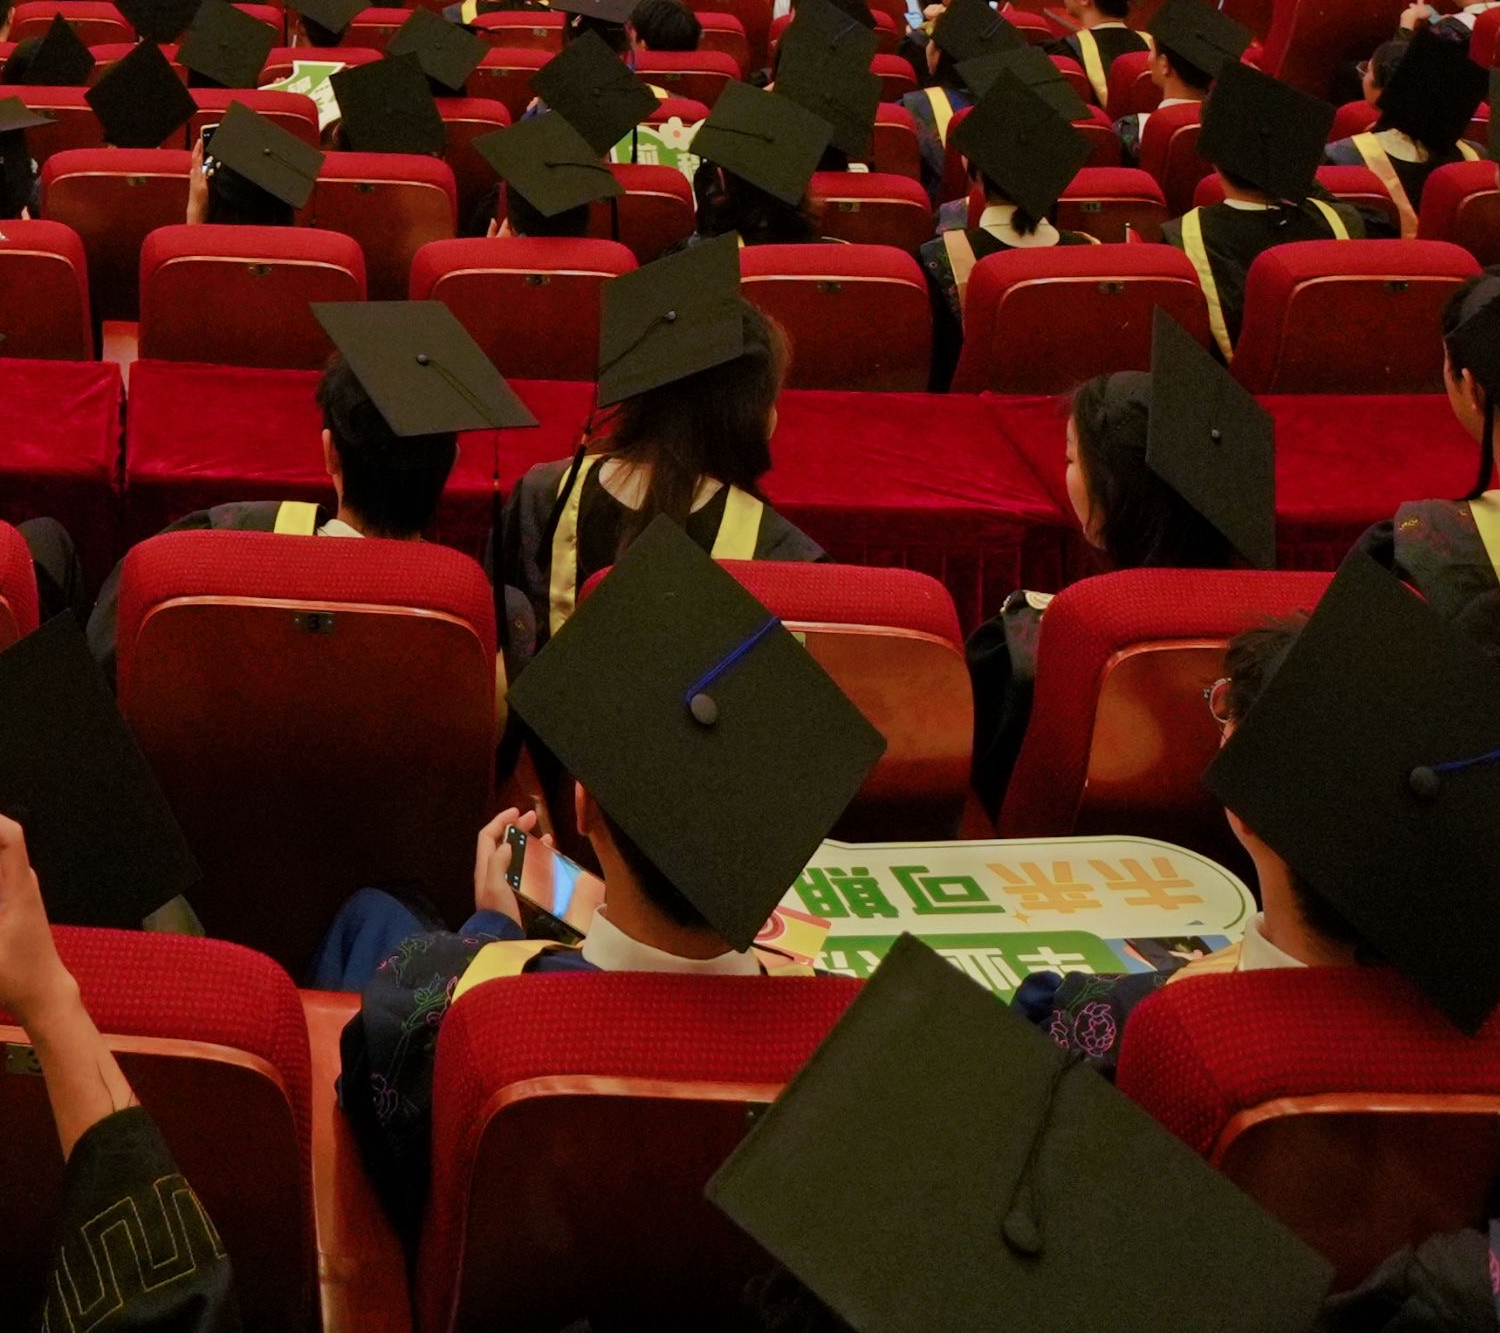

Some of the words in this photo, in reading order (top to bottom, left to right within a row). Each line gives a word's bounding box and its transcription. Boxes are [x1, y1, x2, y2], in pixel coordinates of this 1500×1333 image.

[308, 614, 319, 631] 3
[791, 857, 1204, 919] 未来可期
